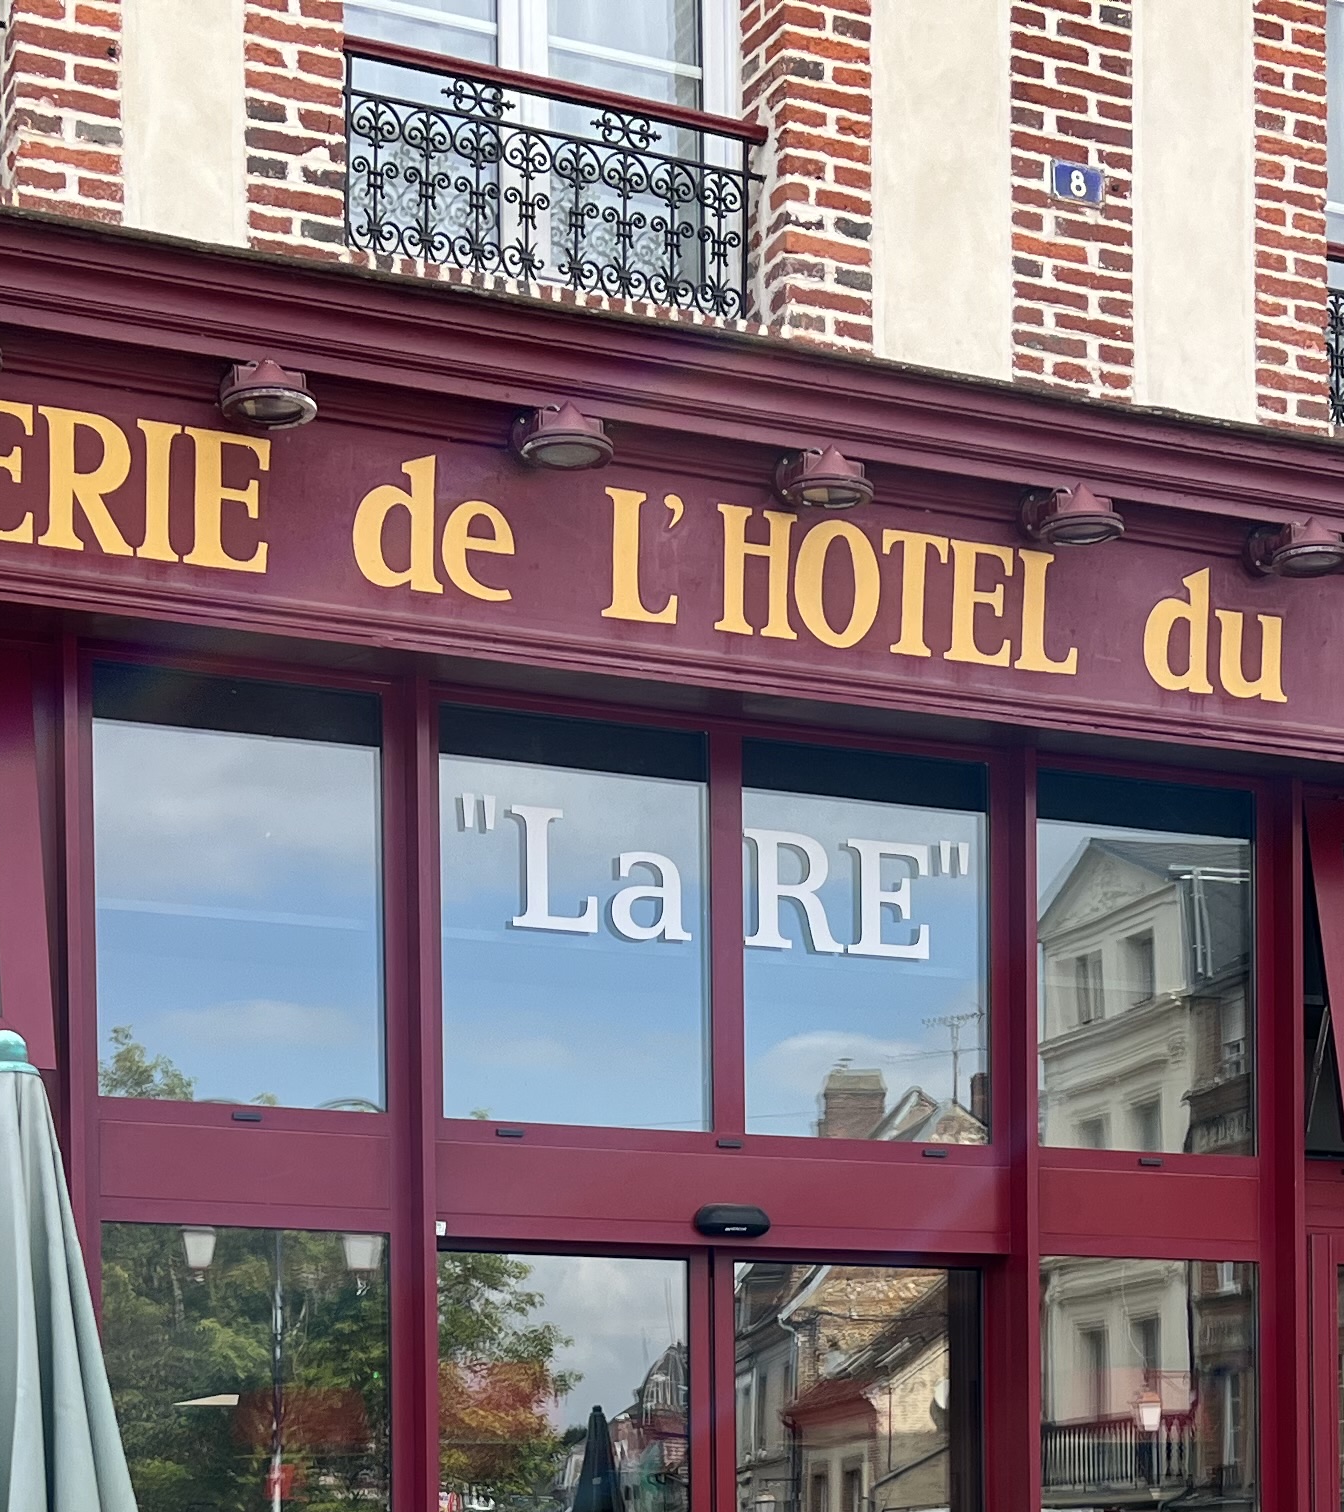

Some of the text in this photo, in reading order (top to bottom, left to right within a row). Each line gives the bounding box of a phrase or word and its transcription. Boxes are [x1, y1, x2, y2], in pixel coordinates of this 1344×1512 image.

[1070, 169, 1087, 198] 8
[351, 453, 516, 602] de
[1142, 566, 1288, 704] du
